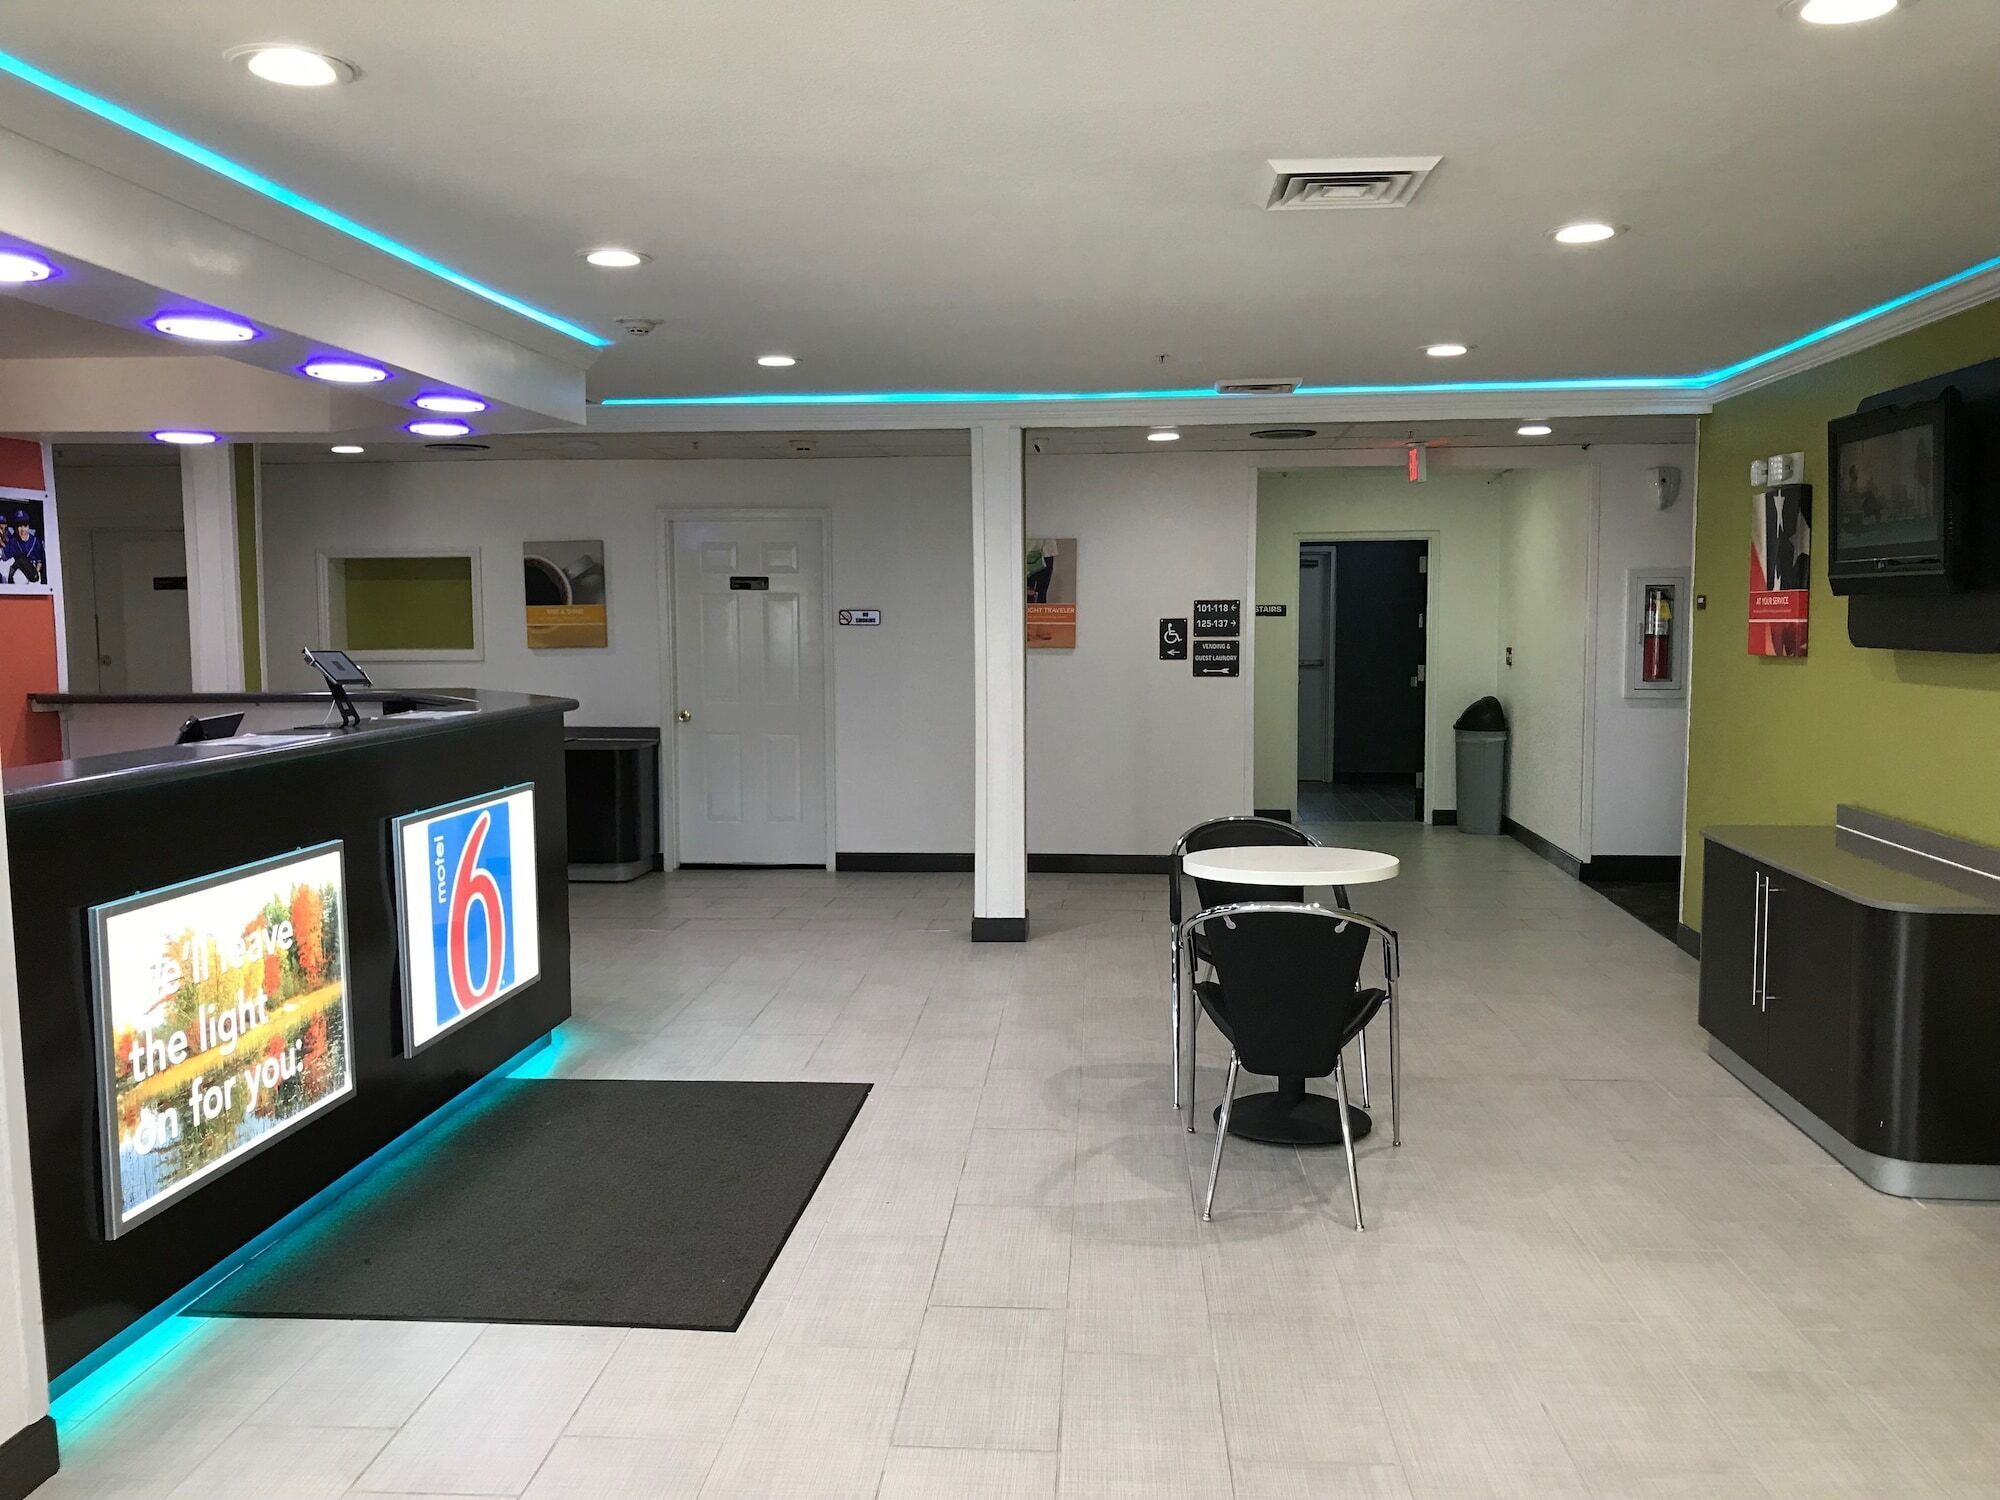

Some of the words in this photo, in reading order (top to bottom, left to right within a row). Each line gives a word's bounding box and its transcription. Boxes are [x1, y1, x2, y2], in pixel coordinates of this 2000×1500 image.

[1196, 604, 1229, 613] 101-118
[1196, 619, 1229, 628] 125-137
[433, 835, 448, 904] motel
[447, 810, 506, 1014] 6
[218, 920, 294, 976] leave
[128, 1022, 188, 1083] the
[198, 987, 269, 1054] light
[132, 1108, 180, 1156] on
[188, 1077, 237, 1127] for
